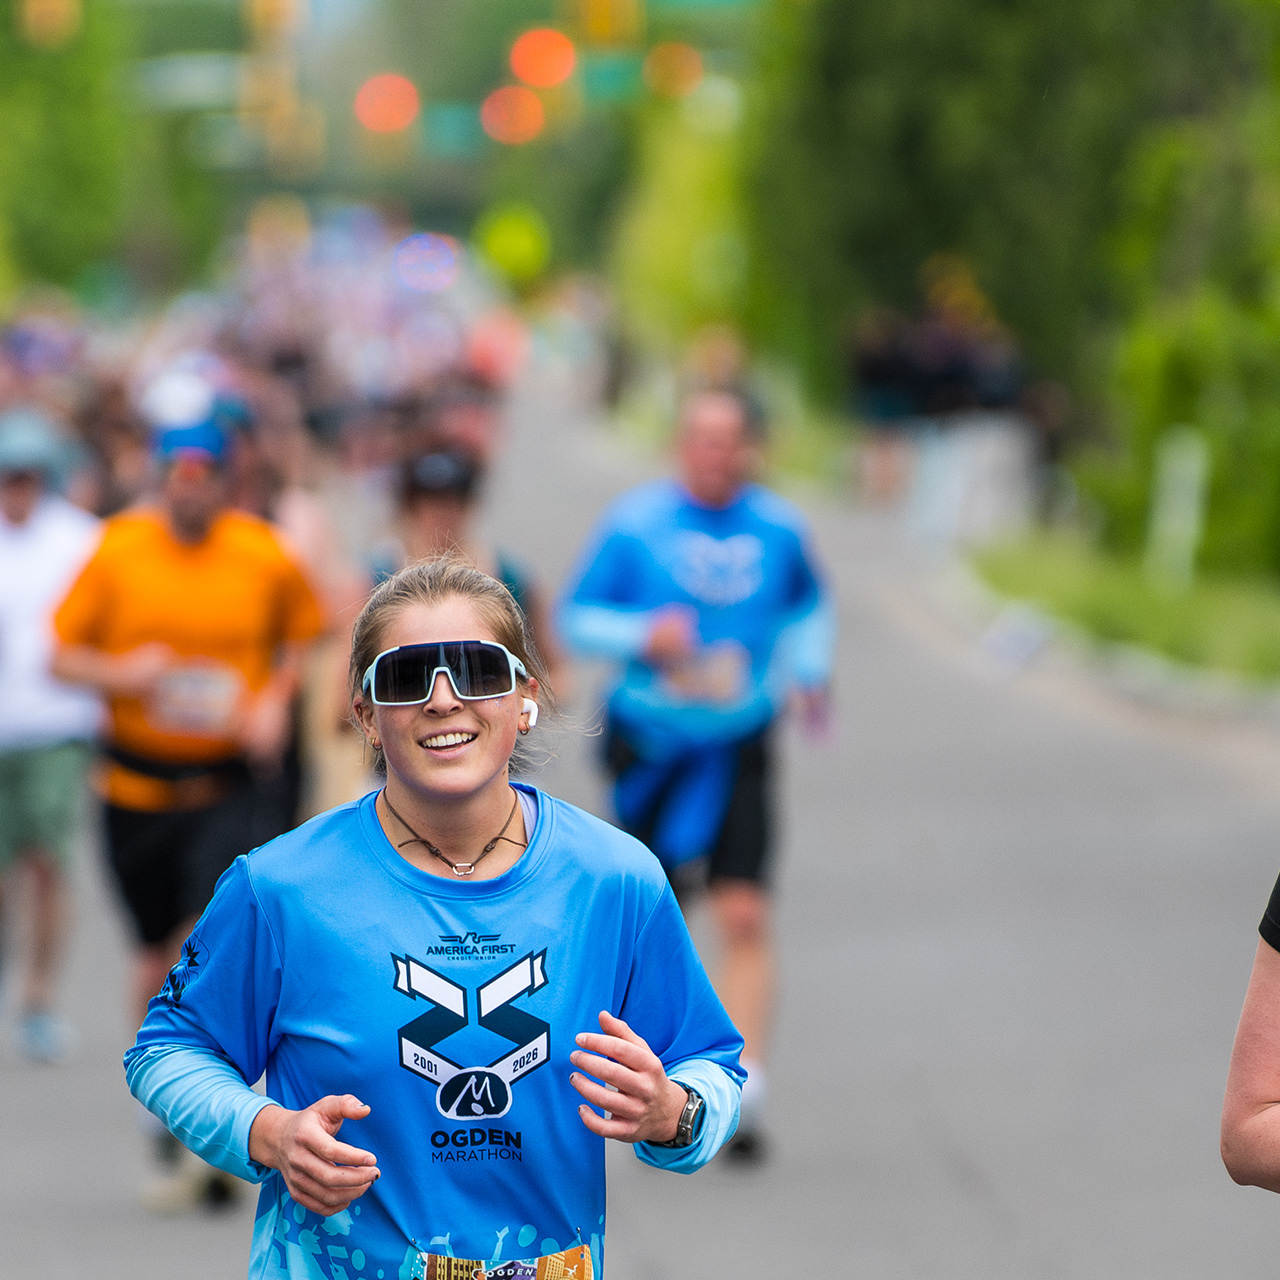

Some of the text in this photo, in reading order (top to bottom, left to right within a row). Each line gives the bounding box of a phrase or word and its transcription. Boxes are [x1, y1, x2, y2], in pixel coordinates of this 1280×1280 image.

[426, 944, 516, 956] AMERICA FIRST
[413, 1052, 438, 1076] 2001
[512, 1047, 539, 1073] 2026
[430, 1128, 522, 1149] OGDEN
[432, 1149, 522, 1164] MARATHON
[486, 1268, 534, 1278] OGDEN
